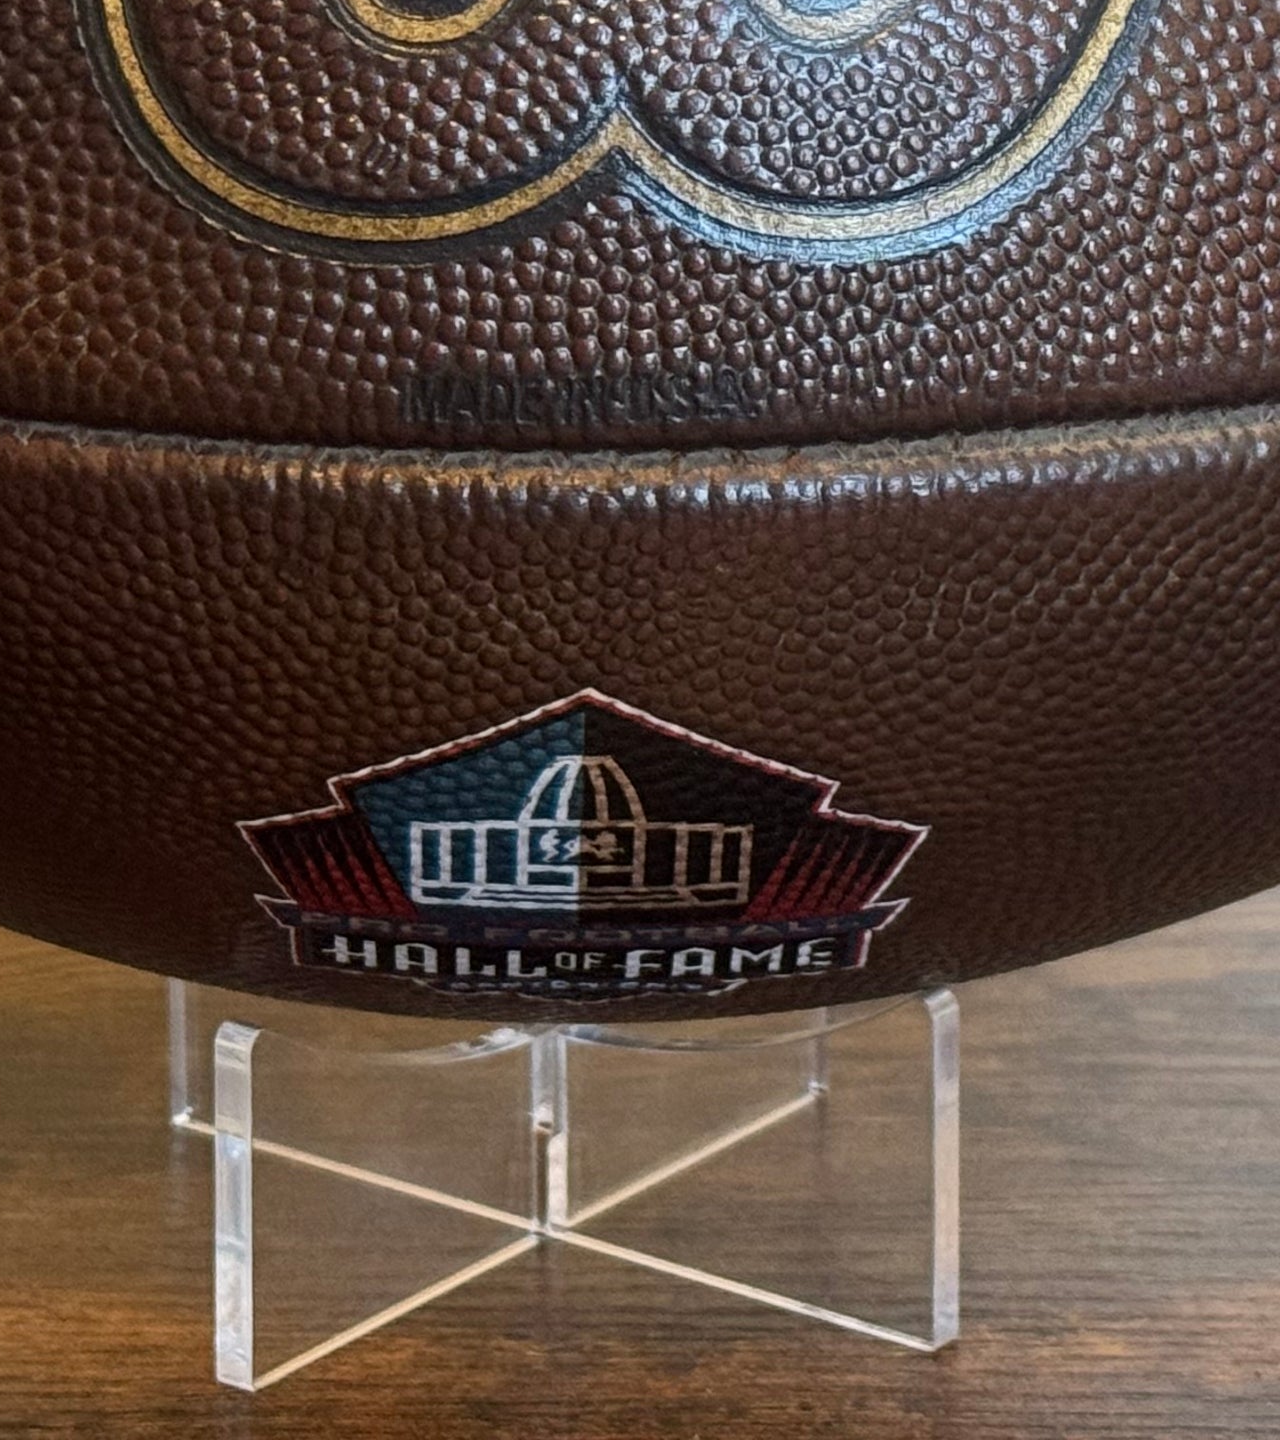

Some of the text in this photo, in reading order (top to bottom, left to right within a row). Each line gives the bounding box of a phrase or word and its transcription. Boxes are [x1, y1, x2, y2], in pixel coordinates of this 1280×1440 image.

[322, 934, 838, 979] HALL OF FAME
